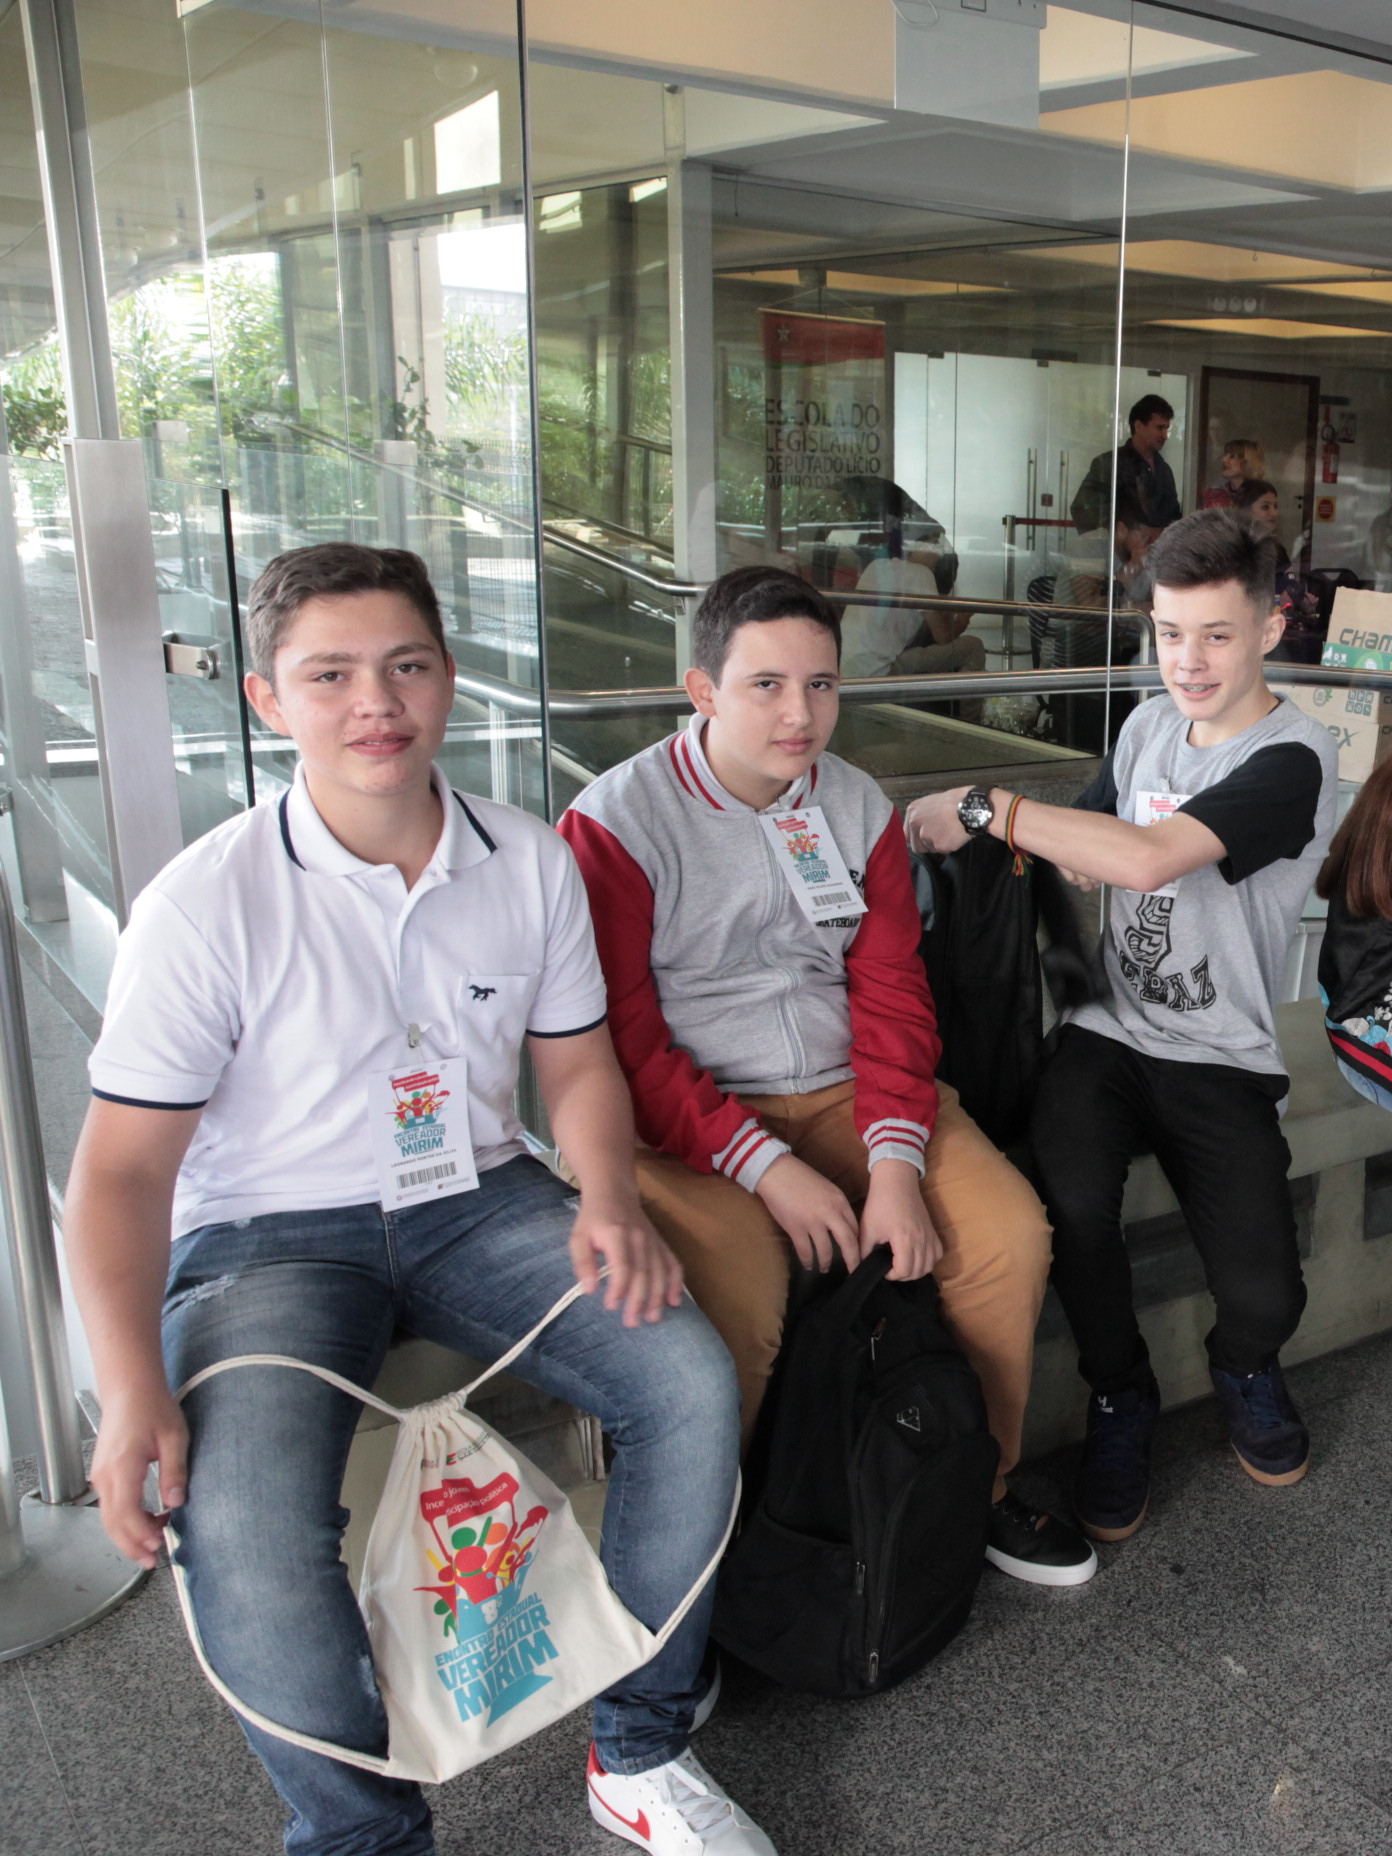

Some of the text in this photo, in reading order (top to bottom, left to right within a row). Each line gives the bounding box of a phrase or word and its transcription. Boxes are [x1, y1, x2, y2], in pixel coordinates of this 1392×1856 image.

[765, 399, 880, 428] ESCOLA DO
[765, 429, 880, 454] LEGISLATIVO
[766, 455, 844, 473] DEPUTADO
[395, 1128, 446, 1147] VEREADOR
[401, 1137, 443, 1157] MIRIM
[437, 1604, 551, 1692] VEREADOR
[454, 1629, 559, 1722] MIRIM
